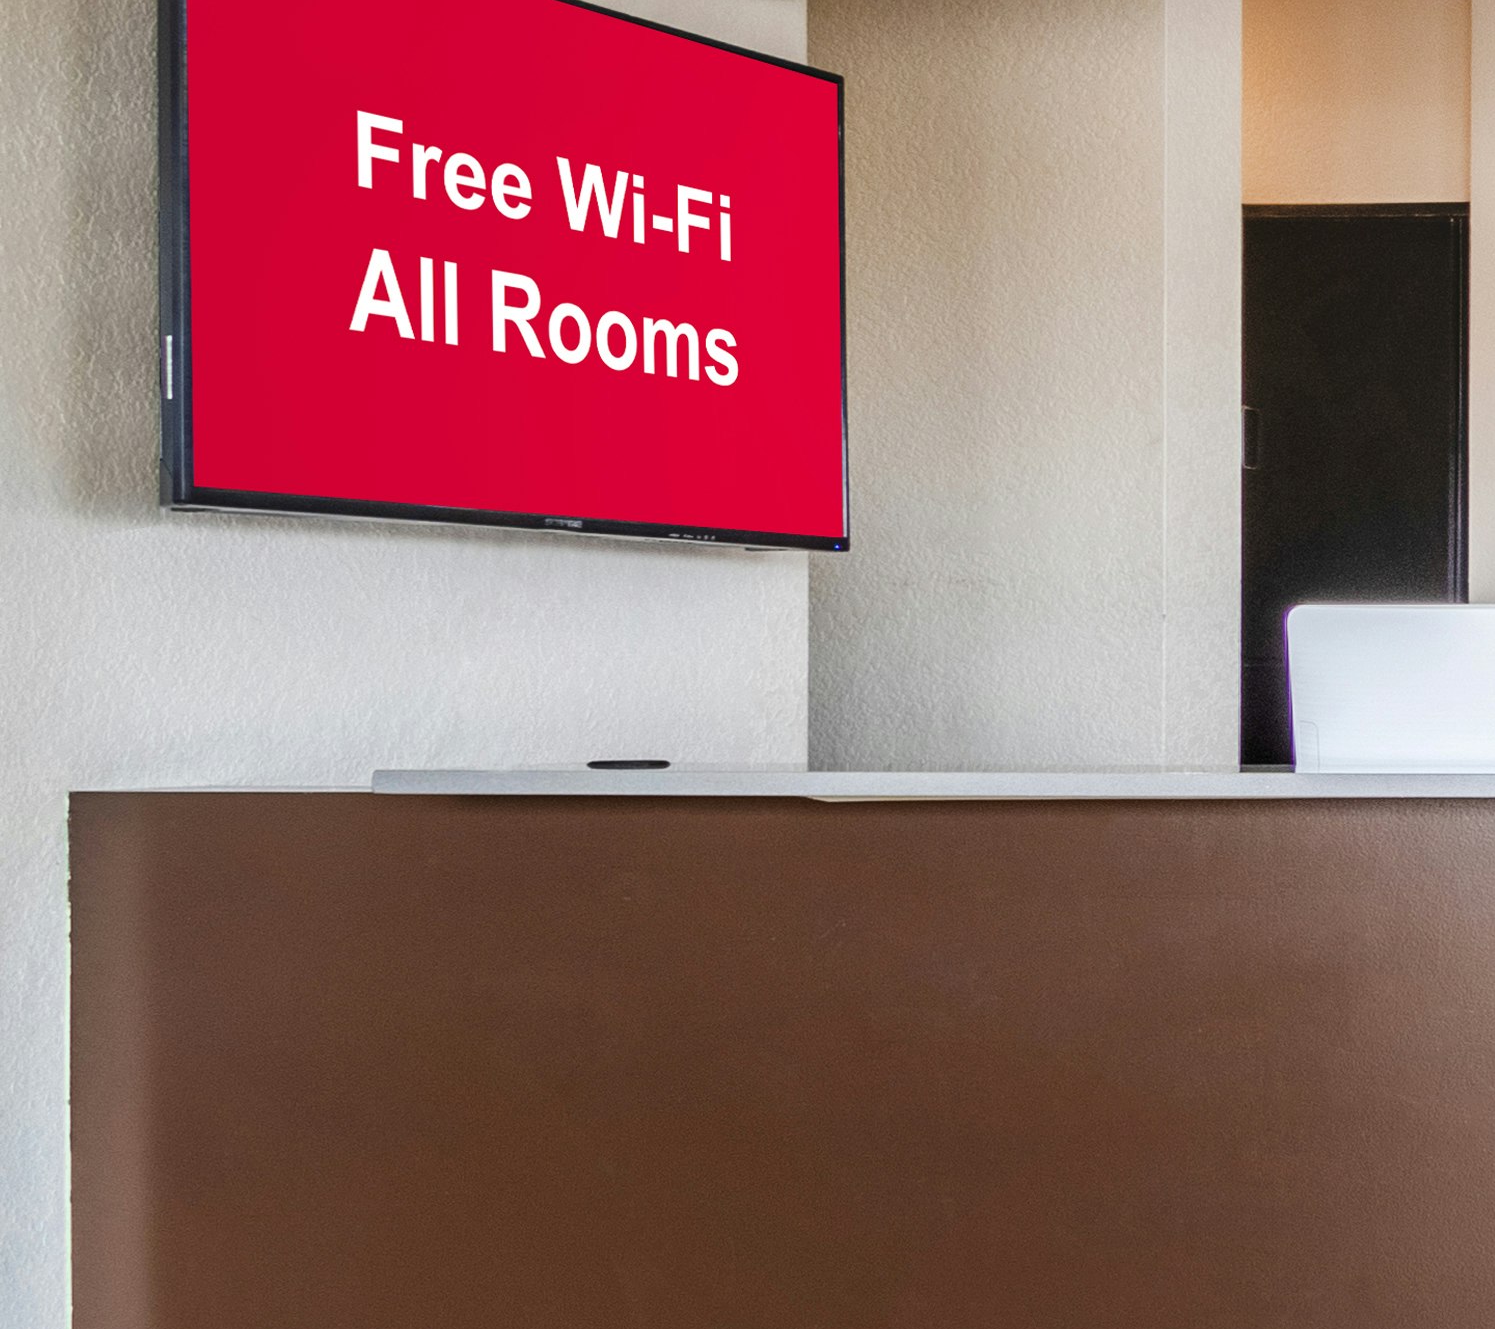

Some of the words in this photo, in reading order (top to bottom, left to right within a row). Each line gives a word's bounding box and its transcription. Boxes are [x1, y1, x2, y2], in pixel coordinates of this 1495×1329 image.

[356, 110, 533, 220] Free
[556, 156, 732, 262] Wi-Fi
[348, 248, 459, 346] All
[491, 269, 740, 387] Rooms
